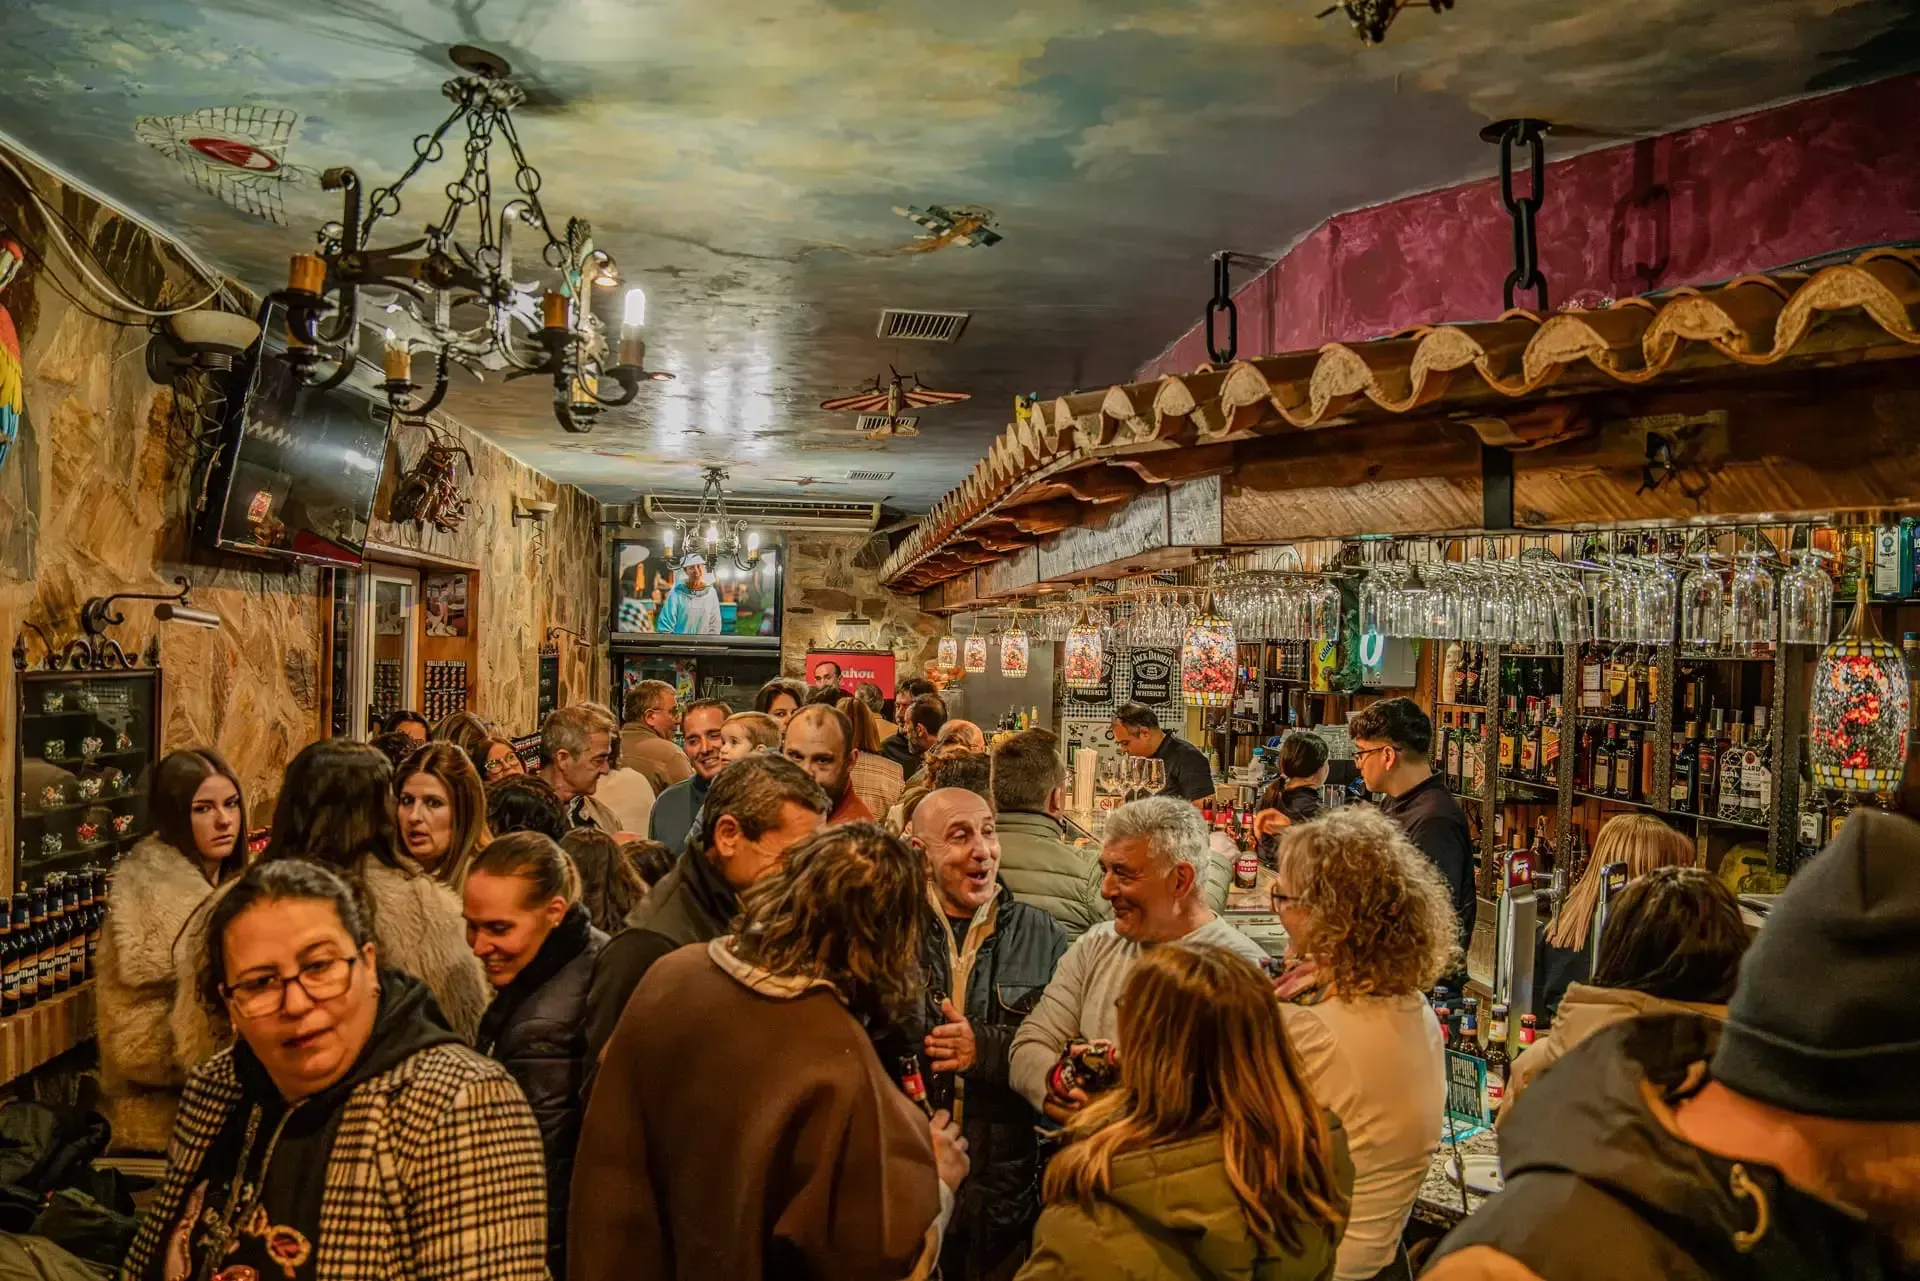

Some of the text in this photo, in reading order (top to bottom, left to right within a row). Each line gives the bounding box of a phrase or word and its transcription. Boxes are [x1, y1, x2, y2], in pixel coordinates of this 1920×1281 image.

[1132, 652, 1148, 665] JACK
[841, 667, 875, 679] ahou
[1136, 681, 1166, 689] Tennessee
